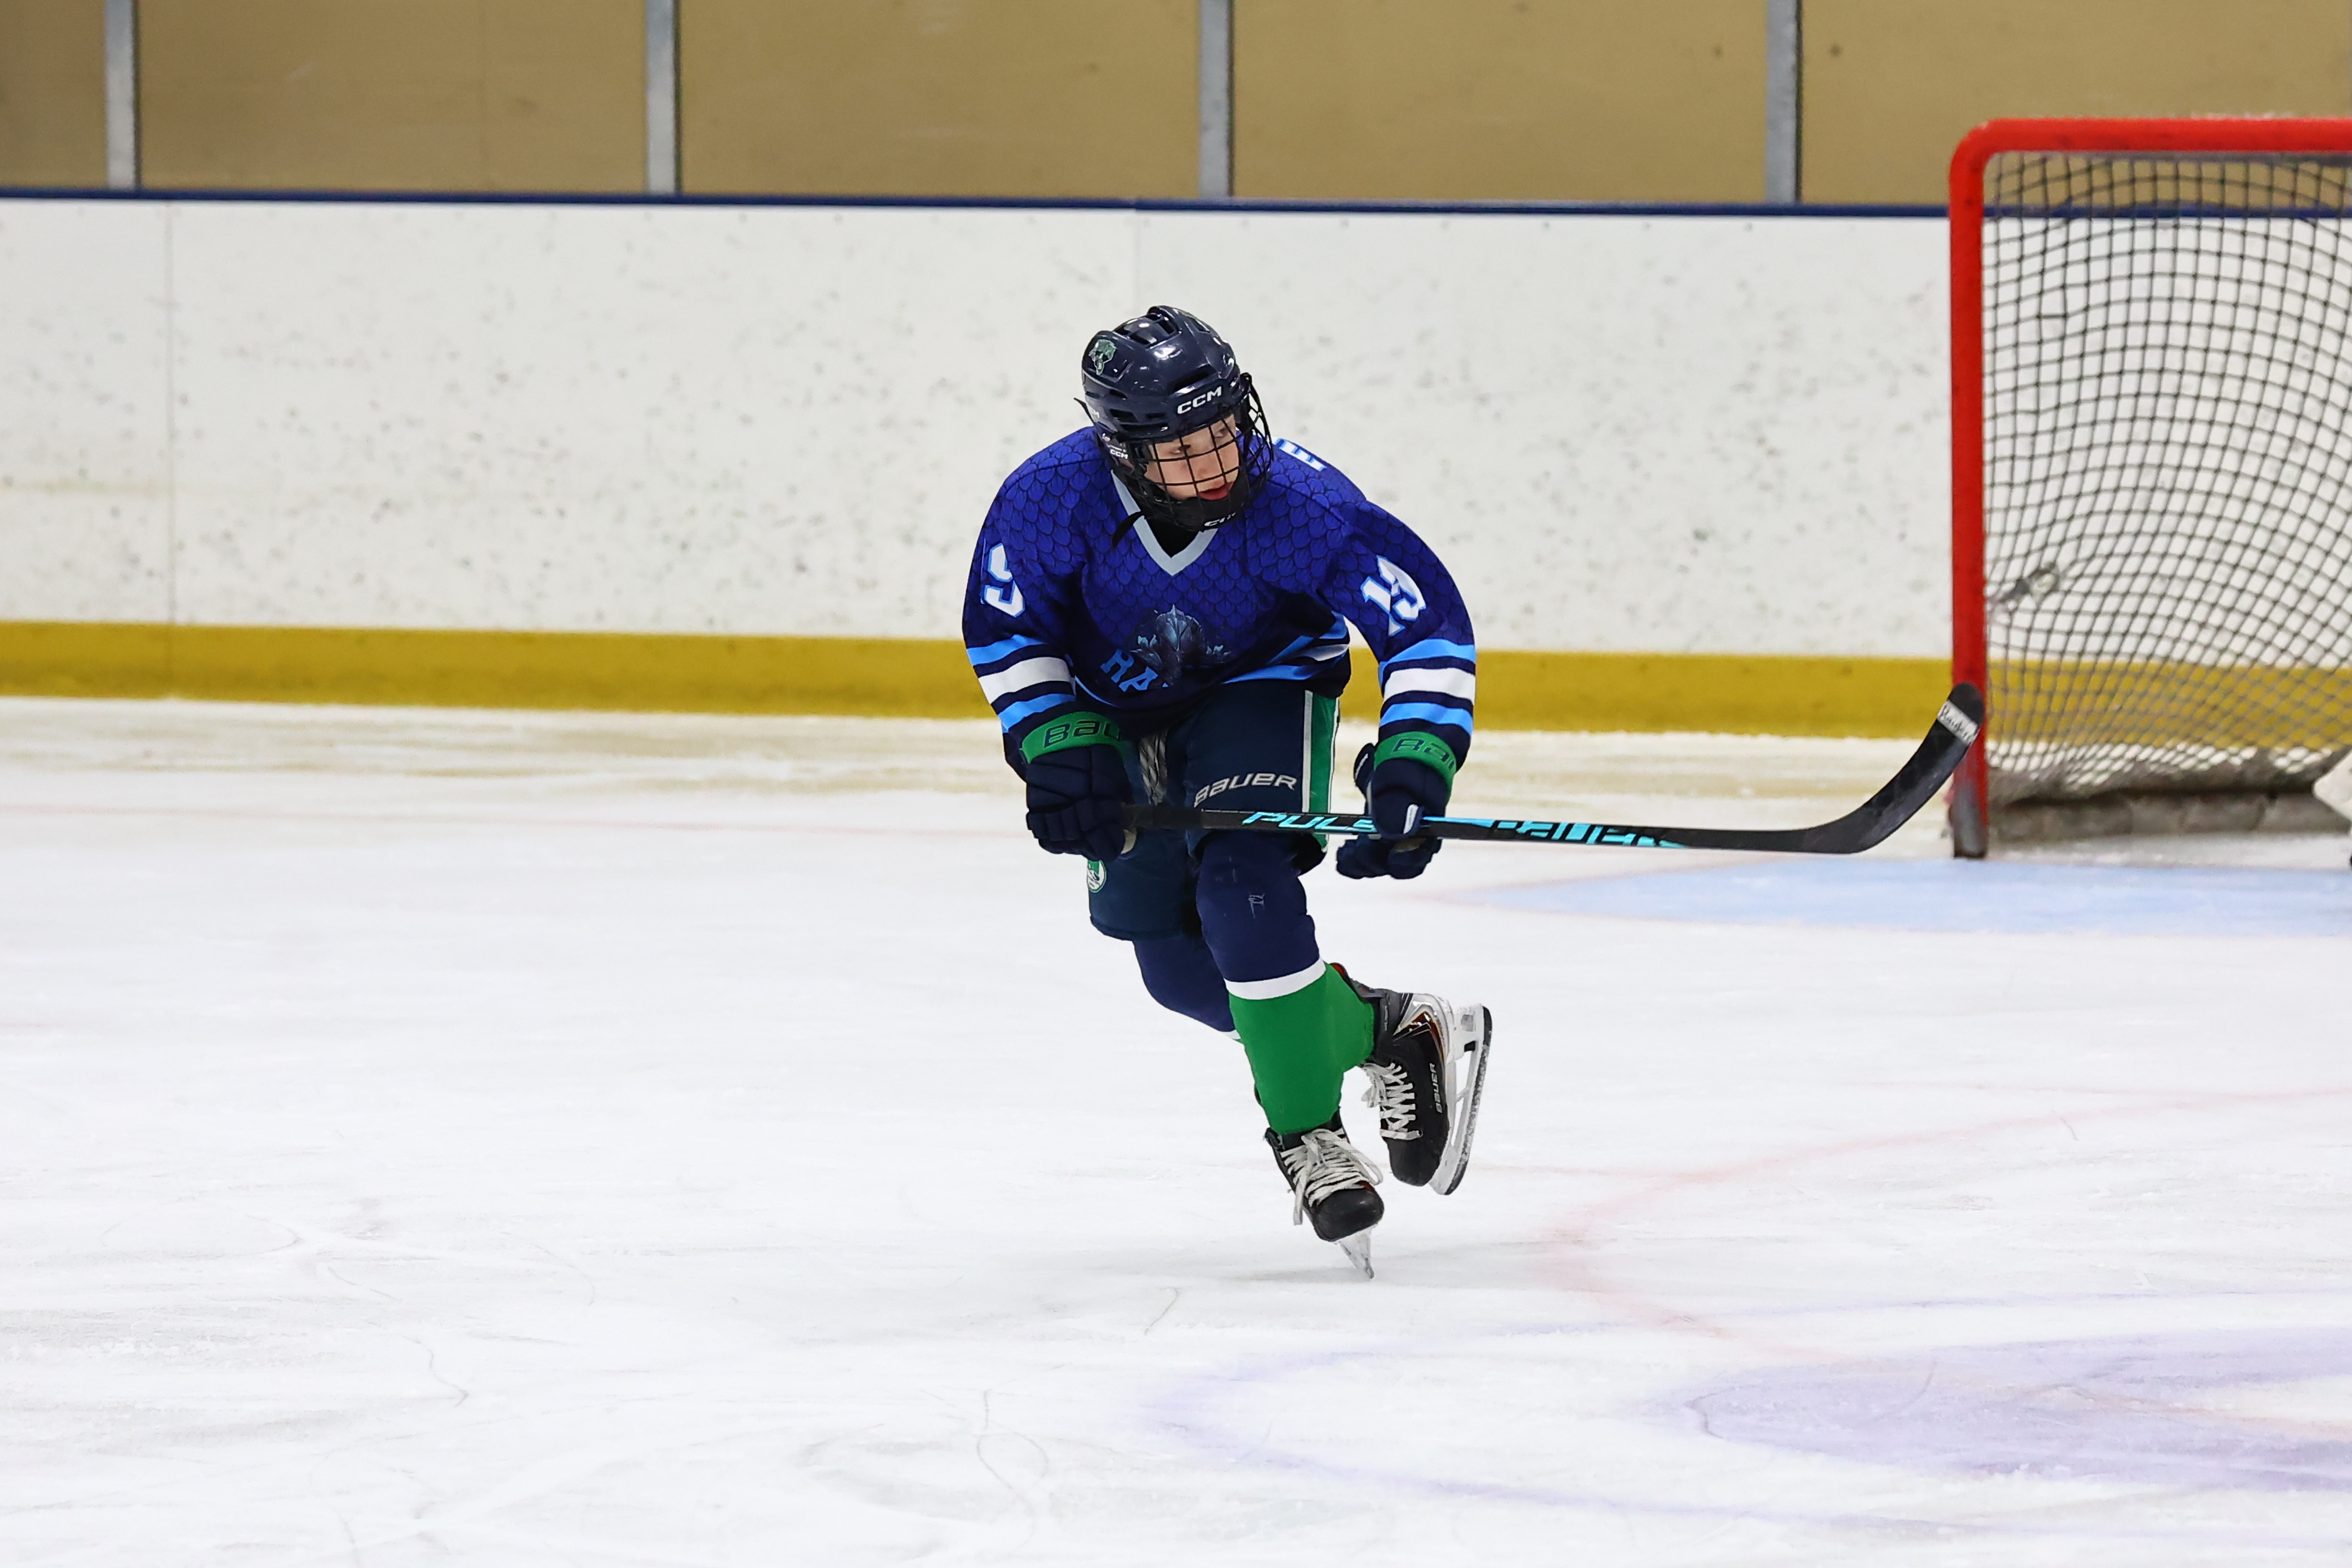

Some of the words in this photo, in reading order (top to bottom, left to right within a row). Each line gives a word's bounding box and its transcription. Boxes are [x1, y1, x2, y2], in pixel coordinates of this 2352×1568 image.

[1177, 386, 1222, 415] CCM
[1110, 449, 1128, 459] CCM
[1043, 720, 1121, 748] BAU
[1194, 773, 1297, 808] BAUER
[1241, 811, 1378, 833] PULS
[1429, 1062, 1442, 1114] BAUER
